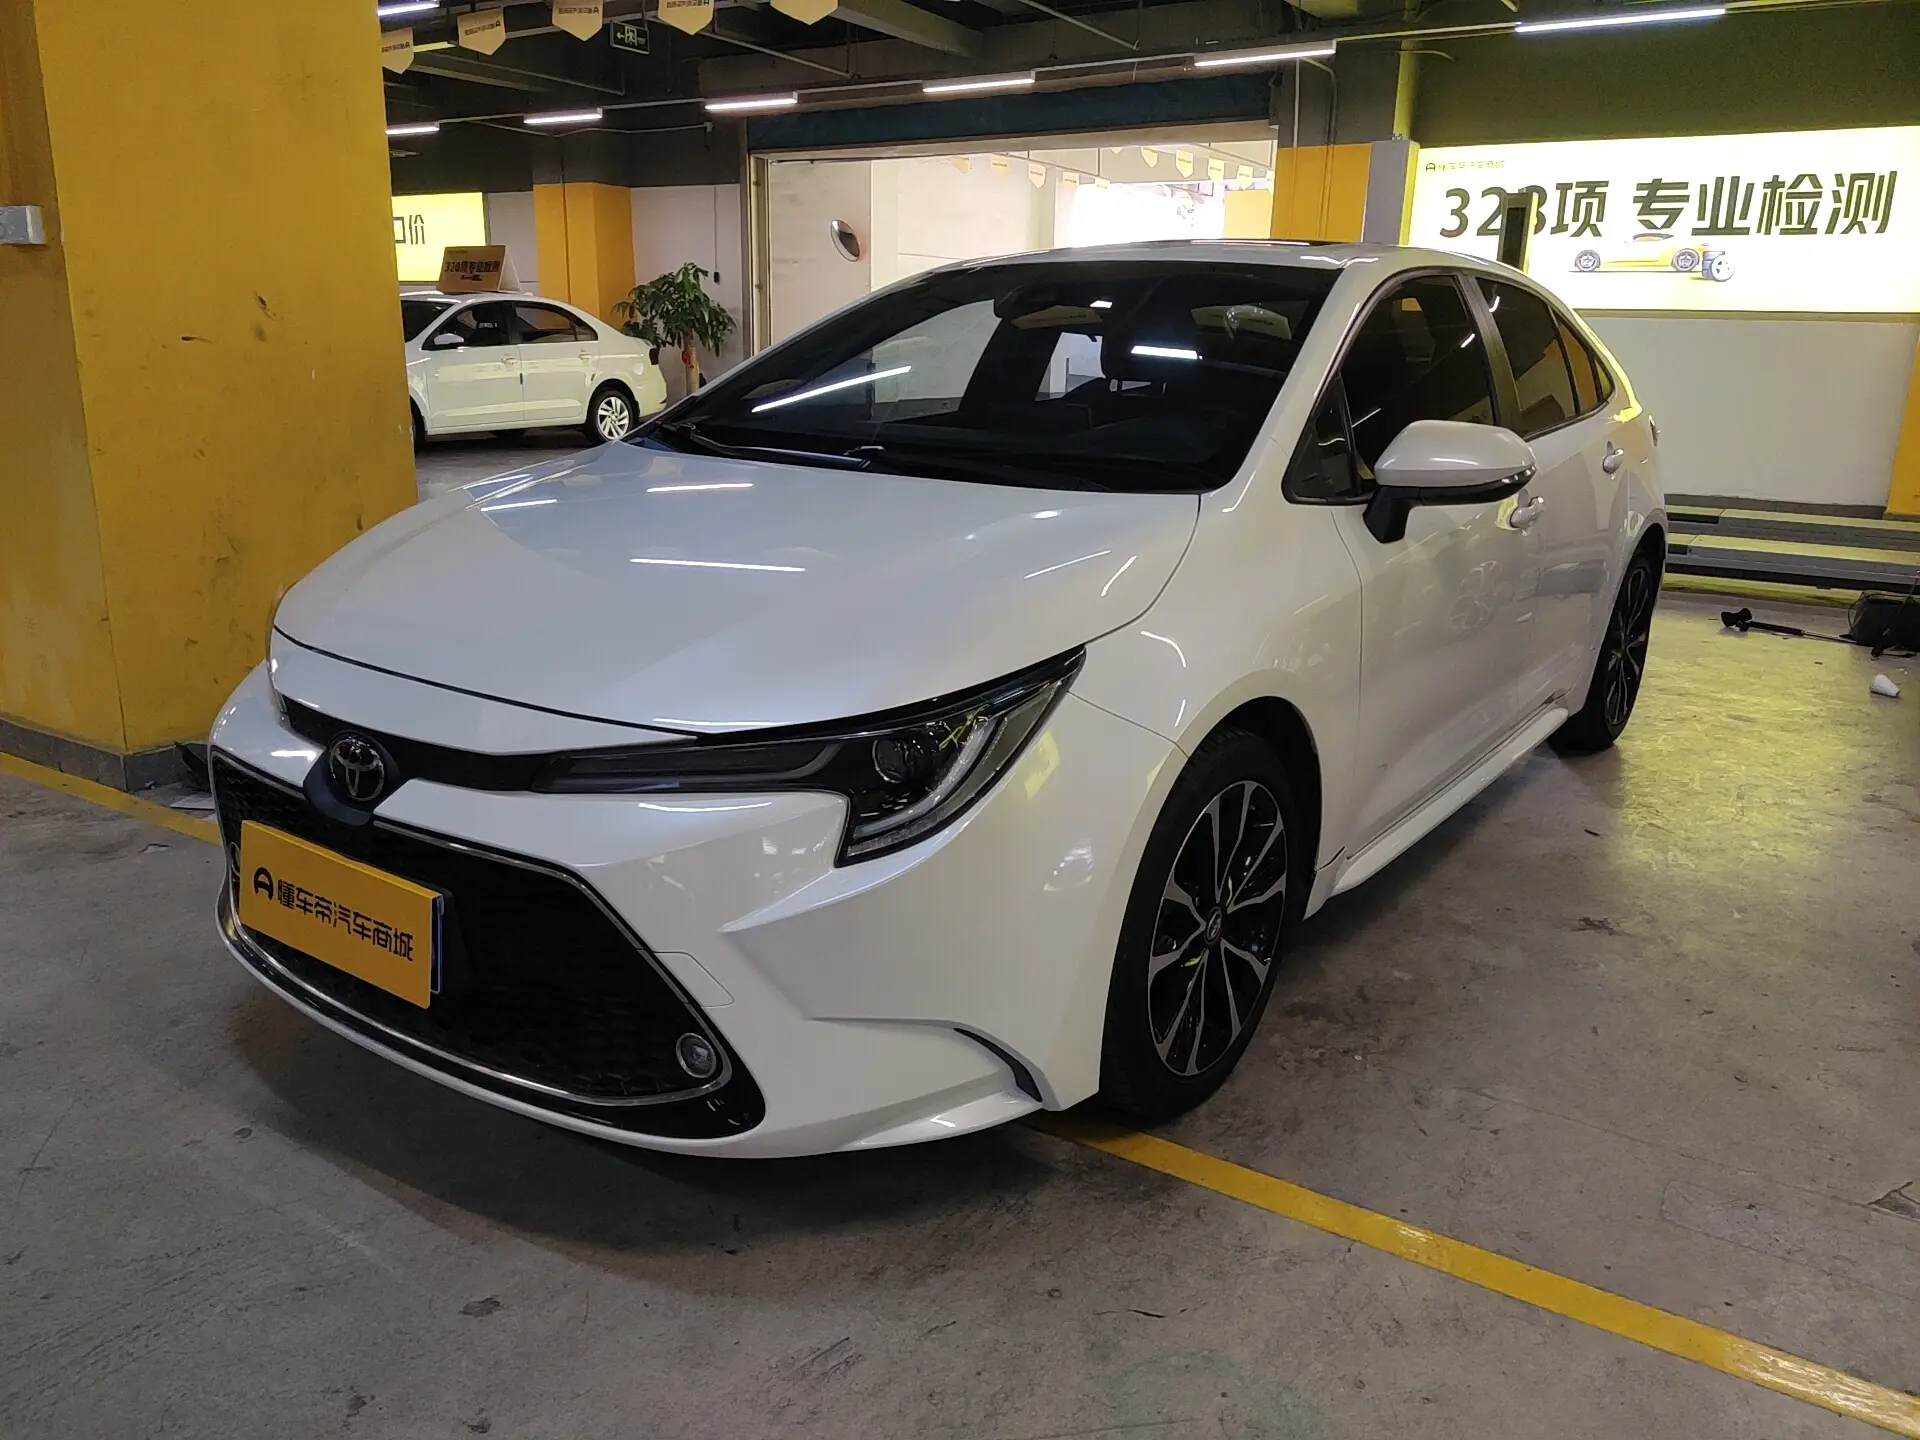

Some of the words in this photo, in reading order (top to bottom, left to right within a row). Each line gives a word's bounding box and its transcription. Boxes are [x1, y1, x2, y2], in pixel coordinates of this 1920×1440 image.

[1632, 171, 1898, 237] 专业检测
[277, 878, 414, 962] 懂车帝汽车商城
